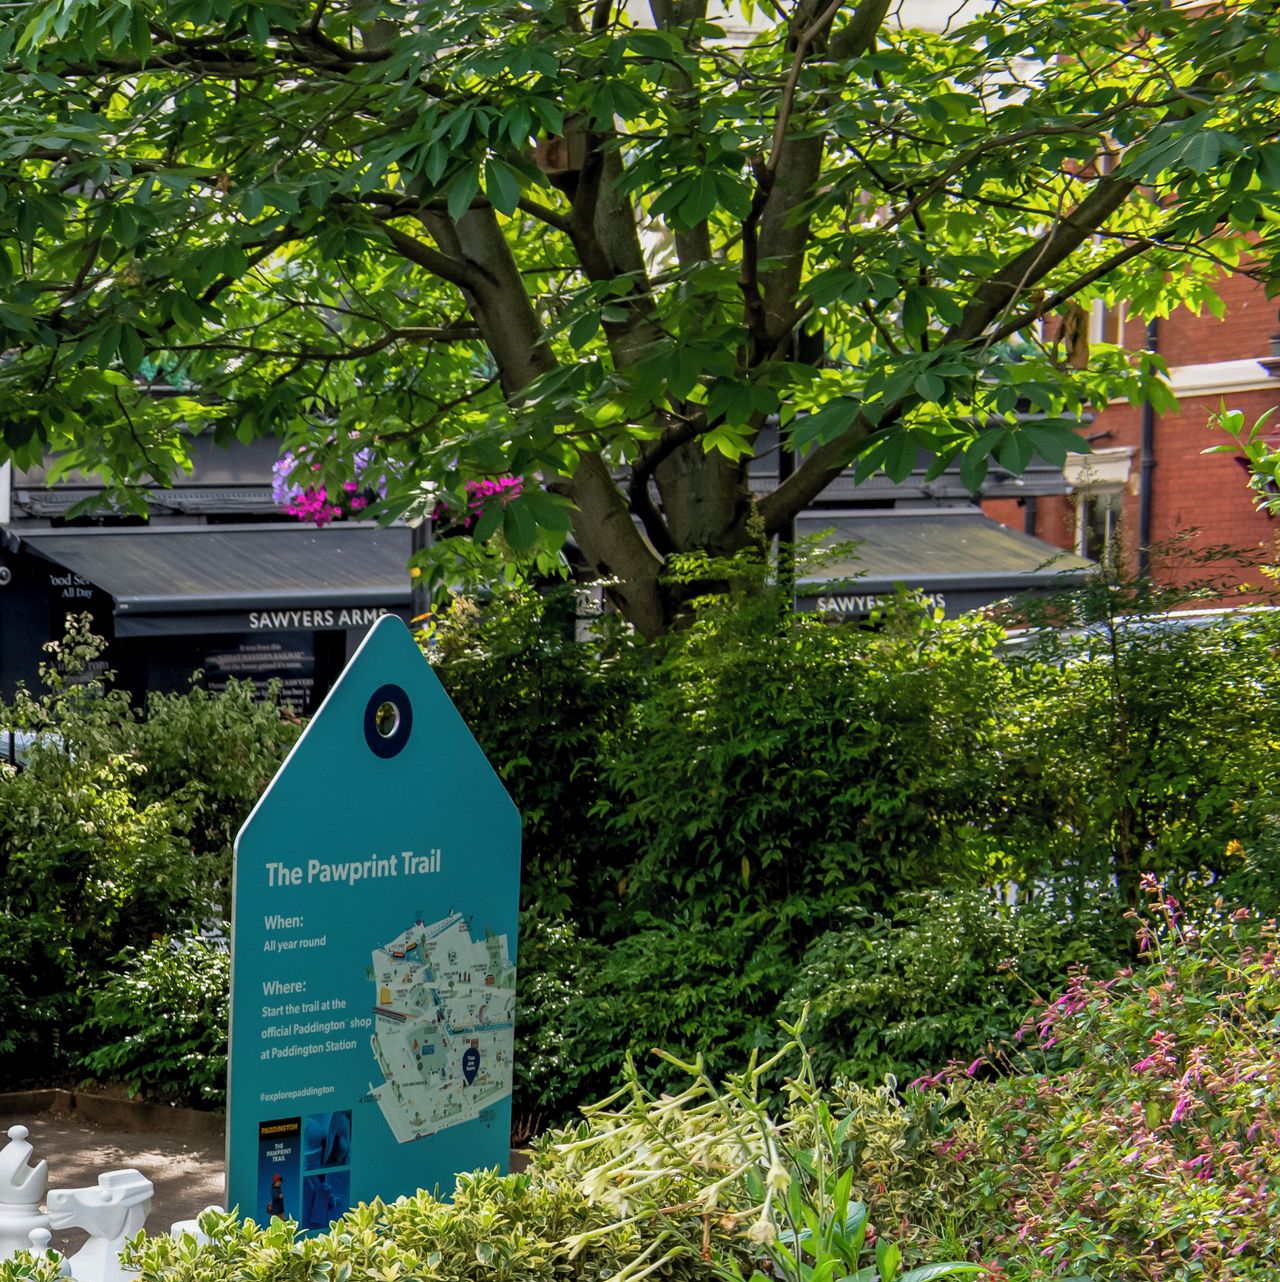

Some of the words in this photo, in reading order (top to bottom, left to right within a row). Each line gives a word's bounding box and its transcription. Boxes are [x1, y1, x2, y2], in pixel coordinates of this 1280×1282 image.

[49, 573, 72, 586] ood
[62, 587, 75, 598] All
[76, 588, 93, 600] Day
[249, 610, 334, 629] SAWYERS
[265, 862, 302, 887] The
[307, 854, 397, 886] Pawprint
[401, 849, 441, 875] Trail
[264, 915, 304, 930] When:
[263, 940, 276, 952] All
[277, 940, 297, 953] year
[299, 935, 326, 949] round
[262, 980, 307, 996] Where:
[261, 1006, 284, 1018] Start
[285, 1003, 300, 1015] the
[301, 1001, 320, 1013] trail
[321, 1001, 330, 1011] at
[331, 998, 347, 1010] the
[261, 1024, 292, 1039] official
[350, 1017, 372, 1029] shop
[260, 1049, 270, 1060] at
[271, 1043, 324, 1057] Paddington
[325, 1039, 357, 1052] Station
[260, 1085, 335, 1102] #explorepaddington
[261, 1123, 298, 1135] PADDINGTON
[266, 1148, 292, 1157] PAWPRINT
